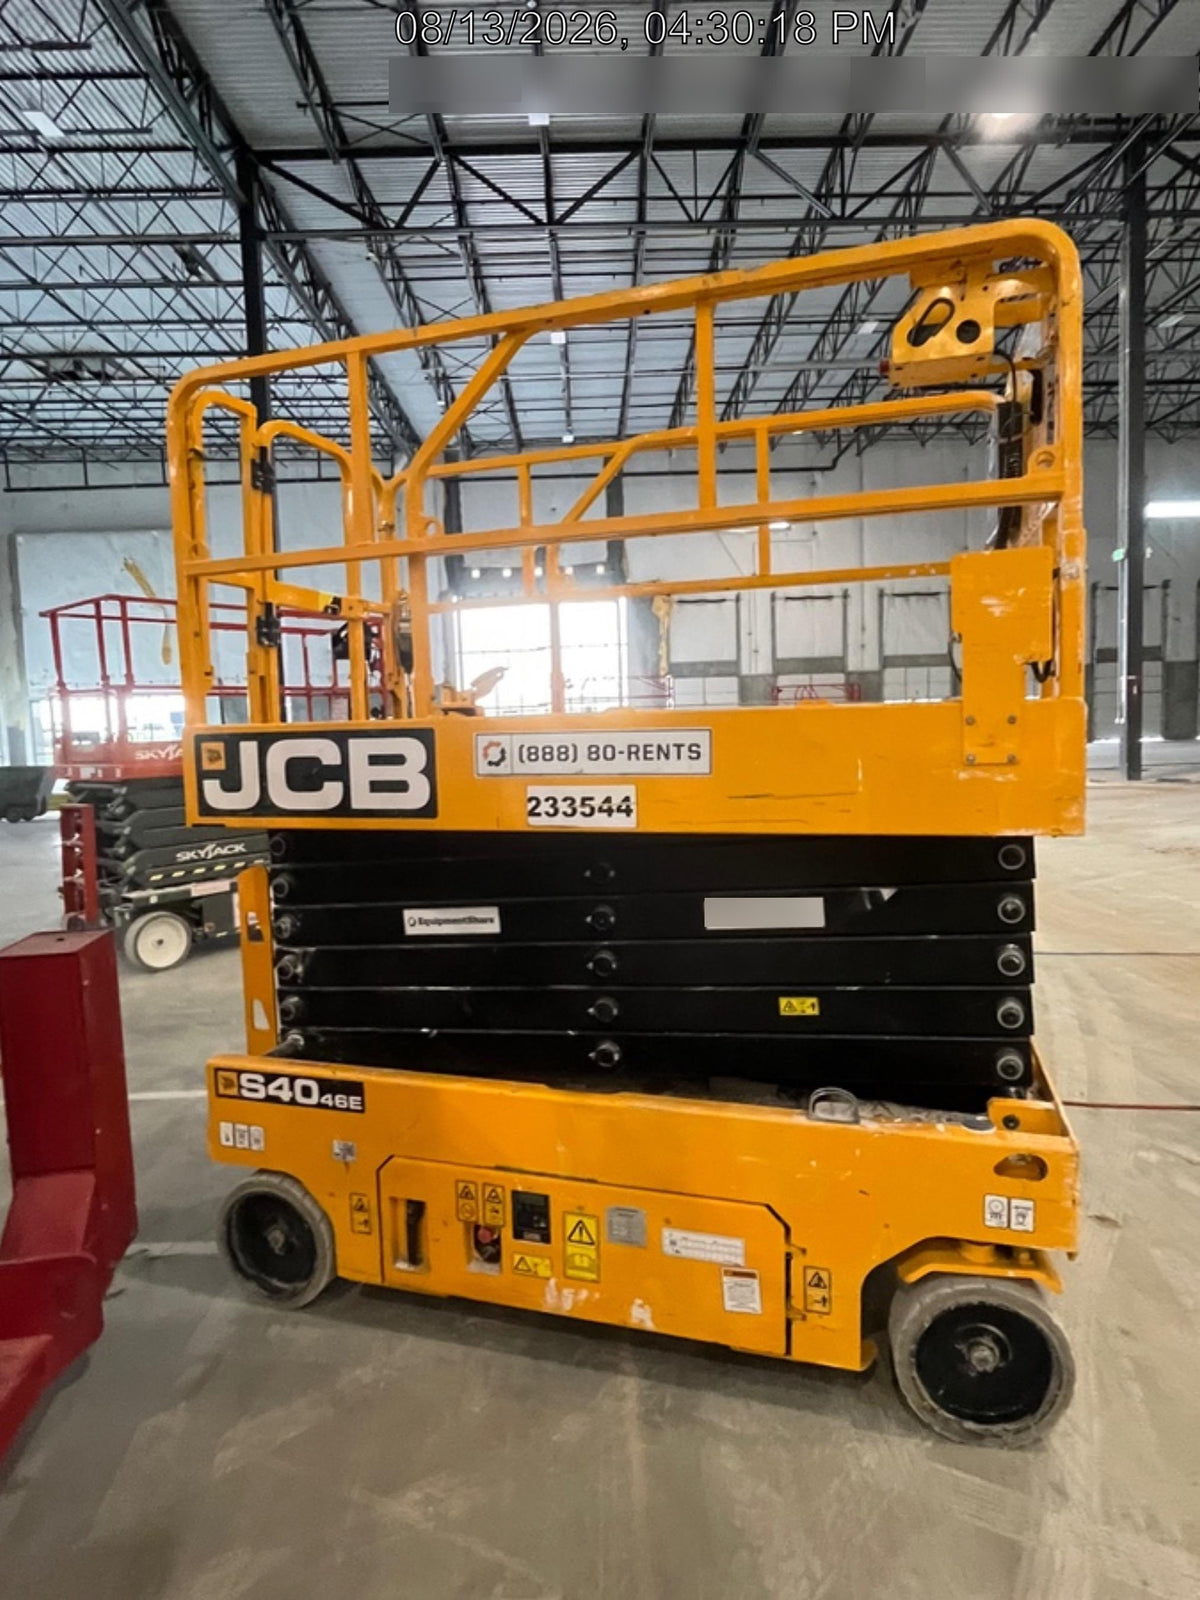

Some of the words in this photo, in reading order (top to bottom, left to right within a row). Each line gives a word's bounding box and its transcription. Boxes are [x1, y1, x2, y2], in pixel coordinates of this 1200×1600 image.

[518, 744, 578, 764] (888)
[587, 743, 702, 762] 80-RENTS
[202, 737, 431, 810] JCB
[526, 795, 634, 818] 233544
[176, 842, 248, 862] SKYJACK
